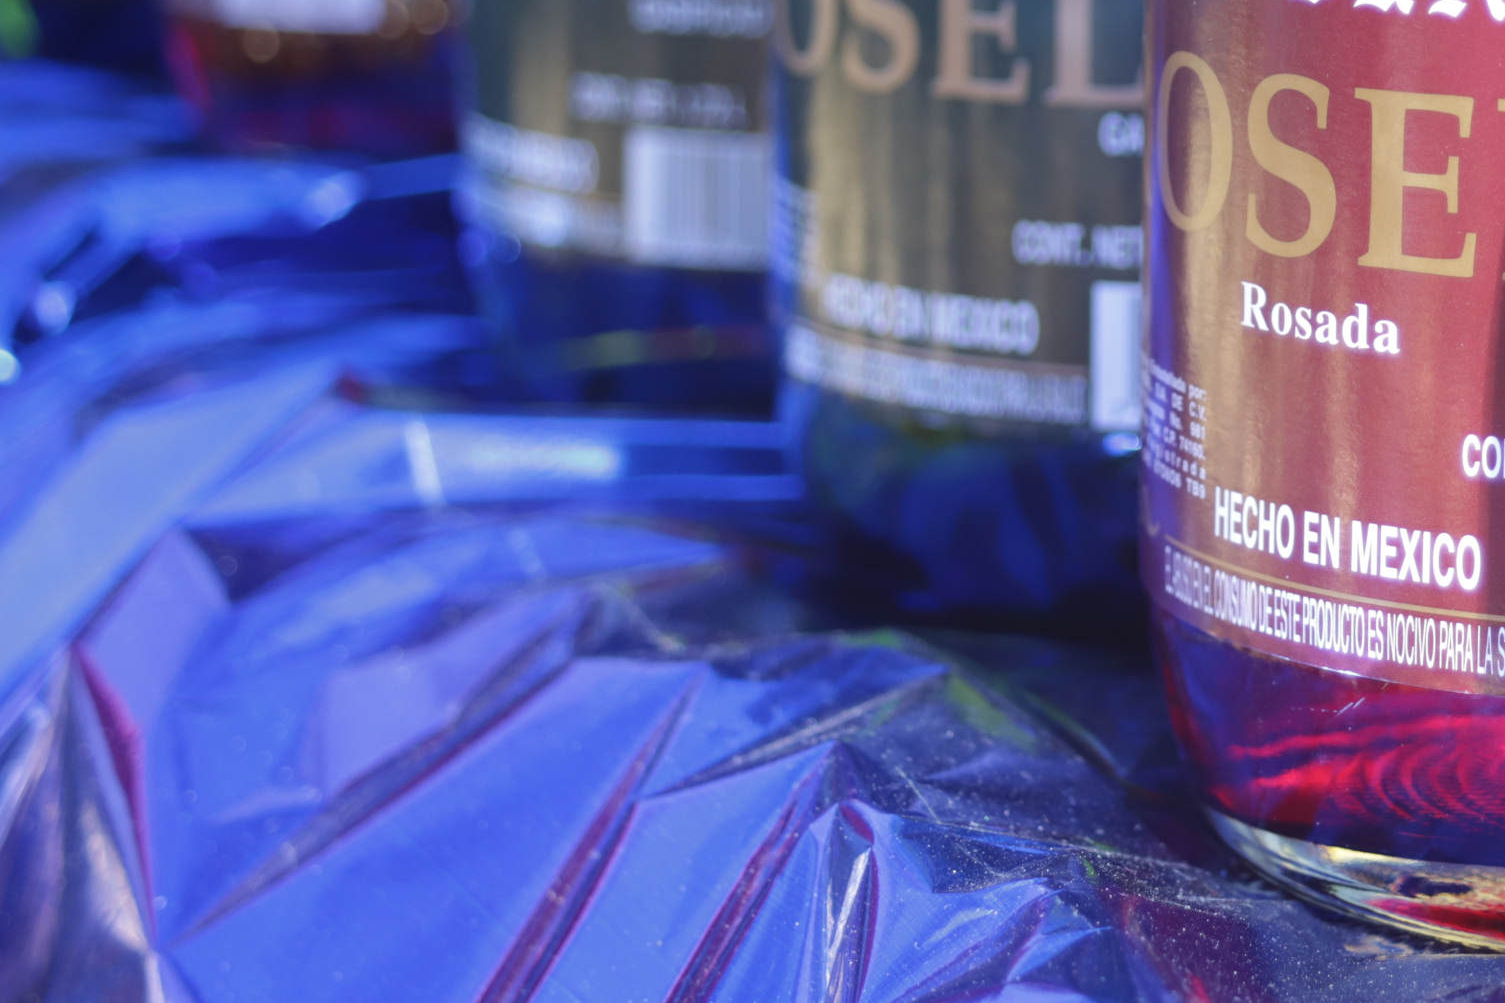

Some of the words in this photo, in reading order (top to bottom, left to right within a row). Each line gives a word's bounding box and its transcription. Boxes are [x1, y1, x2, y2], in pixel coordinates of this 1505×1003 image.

[1240, 281, 1400, 355] Rosada
[1213, 484, 1295, 559] HECHO
[1302, 514, 1341, 570] EN
[1350, 520, 1483, 592] MEXICO
[1258, 585, 1273, 637] DE
[1273, 588, 1301, 644] ESTE
[1302, 595, 1366, 658] PRODUCTO
[1367, 608, 1384, 661] ES
[1386, 612, 1436, 669] NOCIVO
[1439, 620, 1474, 673] PARA
[1477, 625, 1494, 676] LA
